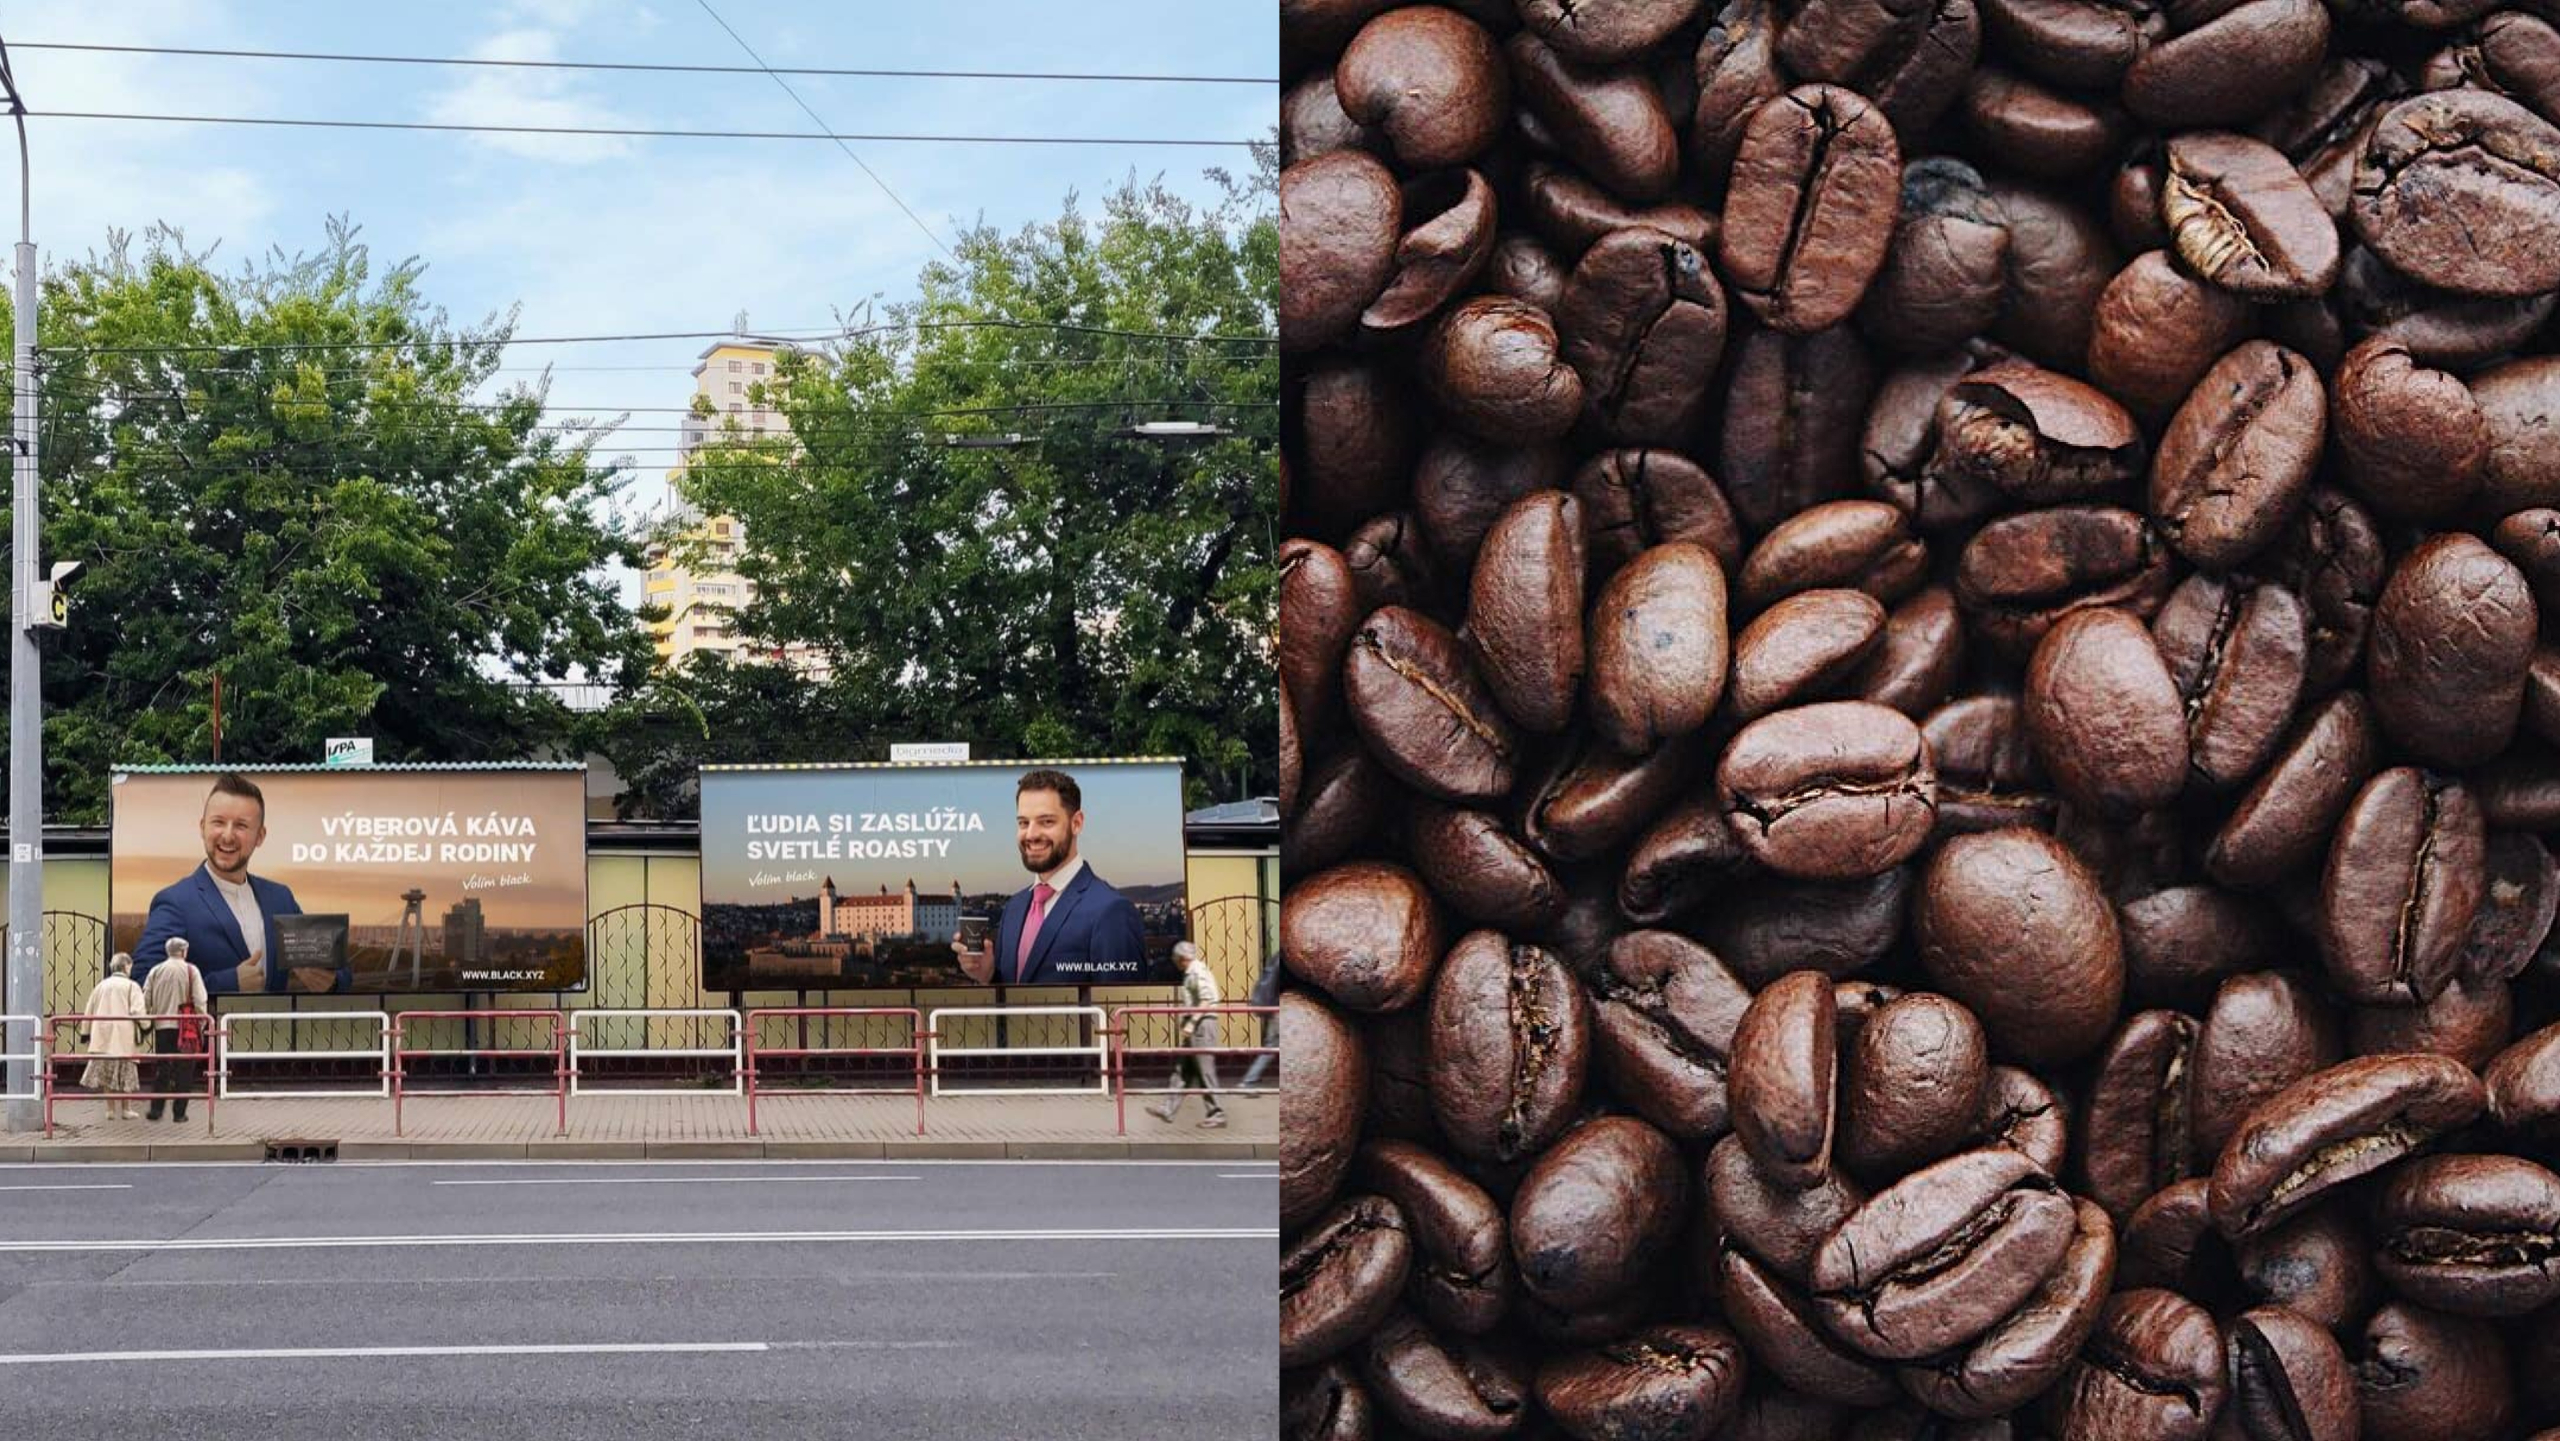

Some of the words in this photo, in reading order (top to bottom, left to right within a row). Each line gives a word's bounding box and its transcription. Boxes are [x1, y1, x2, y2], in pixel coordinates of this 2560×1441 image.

[322, 811, 458, 836] VÝBEROVÁ
[466, 811, 536, 836] KÁVA
[747, 813, 820, 833] ĽUDIA
[829, 814, 852, 832] SI
[860, 807, 984, 832] ZASLÚŽIA
[292, 843, 328, 862] DO
[335, 836, 432, 862] KAŽDEJ
[440, 843, 537, 862] RODINY
[747, 834, 841, 859] SVETLÉ
[849, 839, 951, 858] ROASTY
[500, 872, 532, 887] black
[785, 869, 817, 882] black
[462, 970, 545, 980] WWW.BLACK.XYZ
[1056, 961, 1138, 972] WWW.BLACK.XYZ
